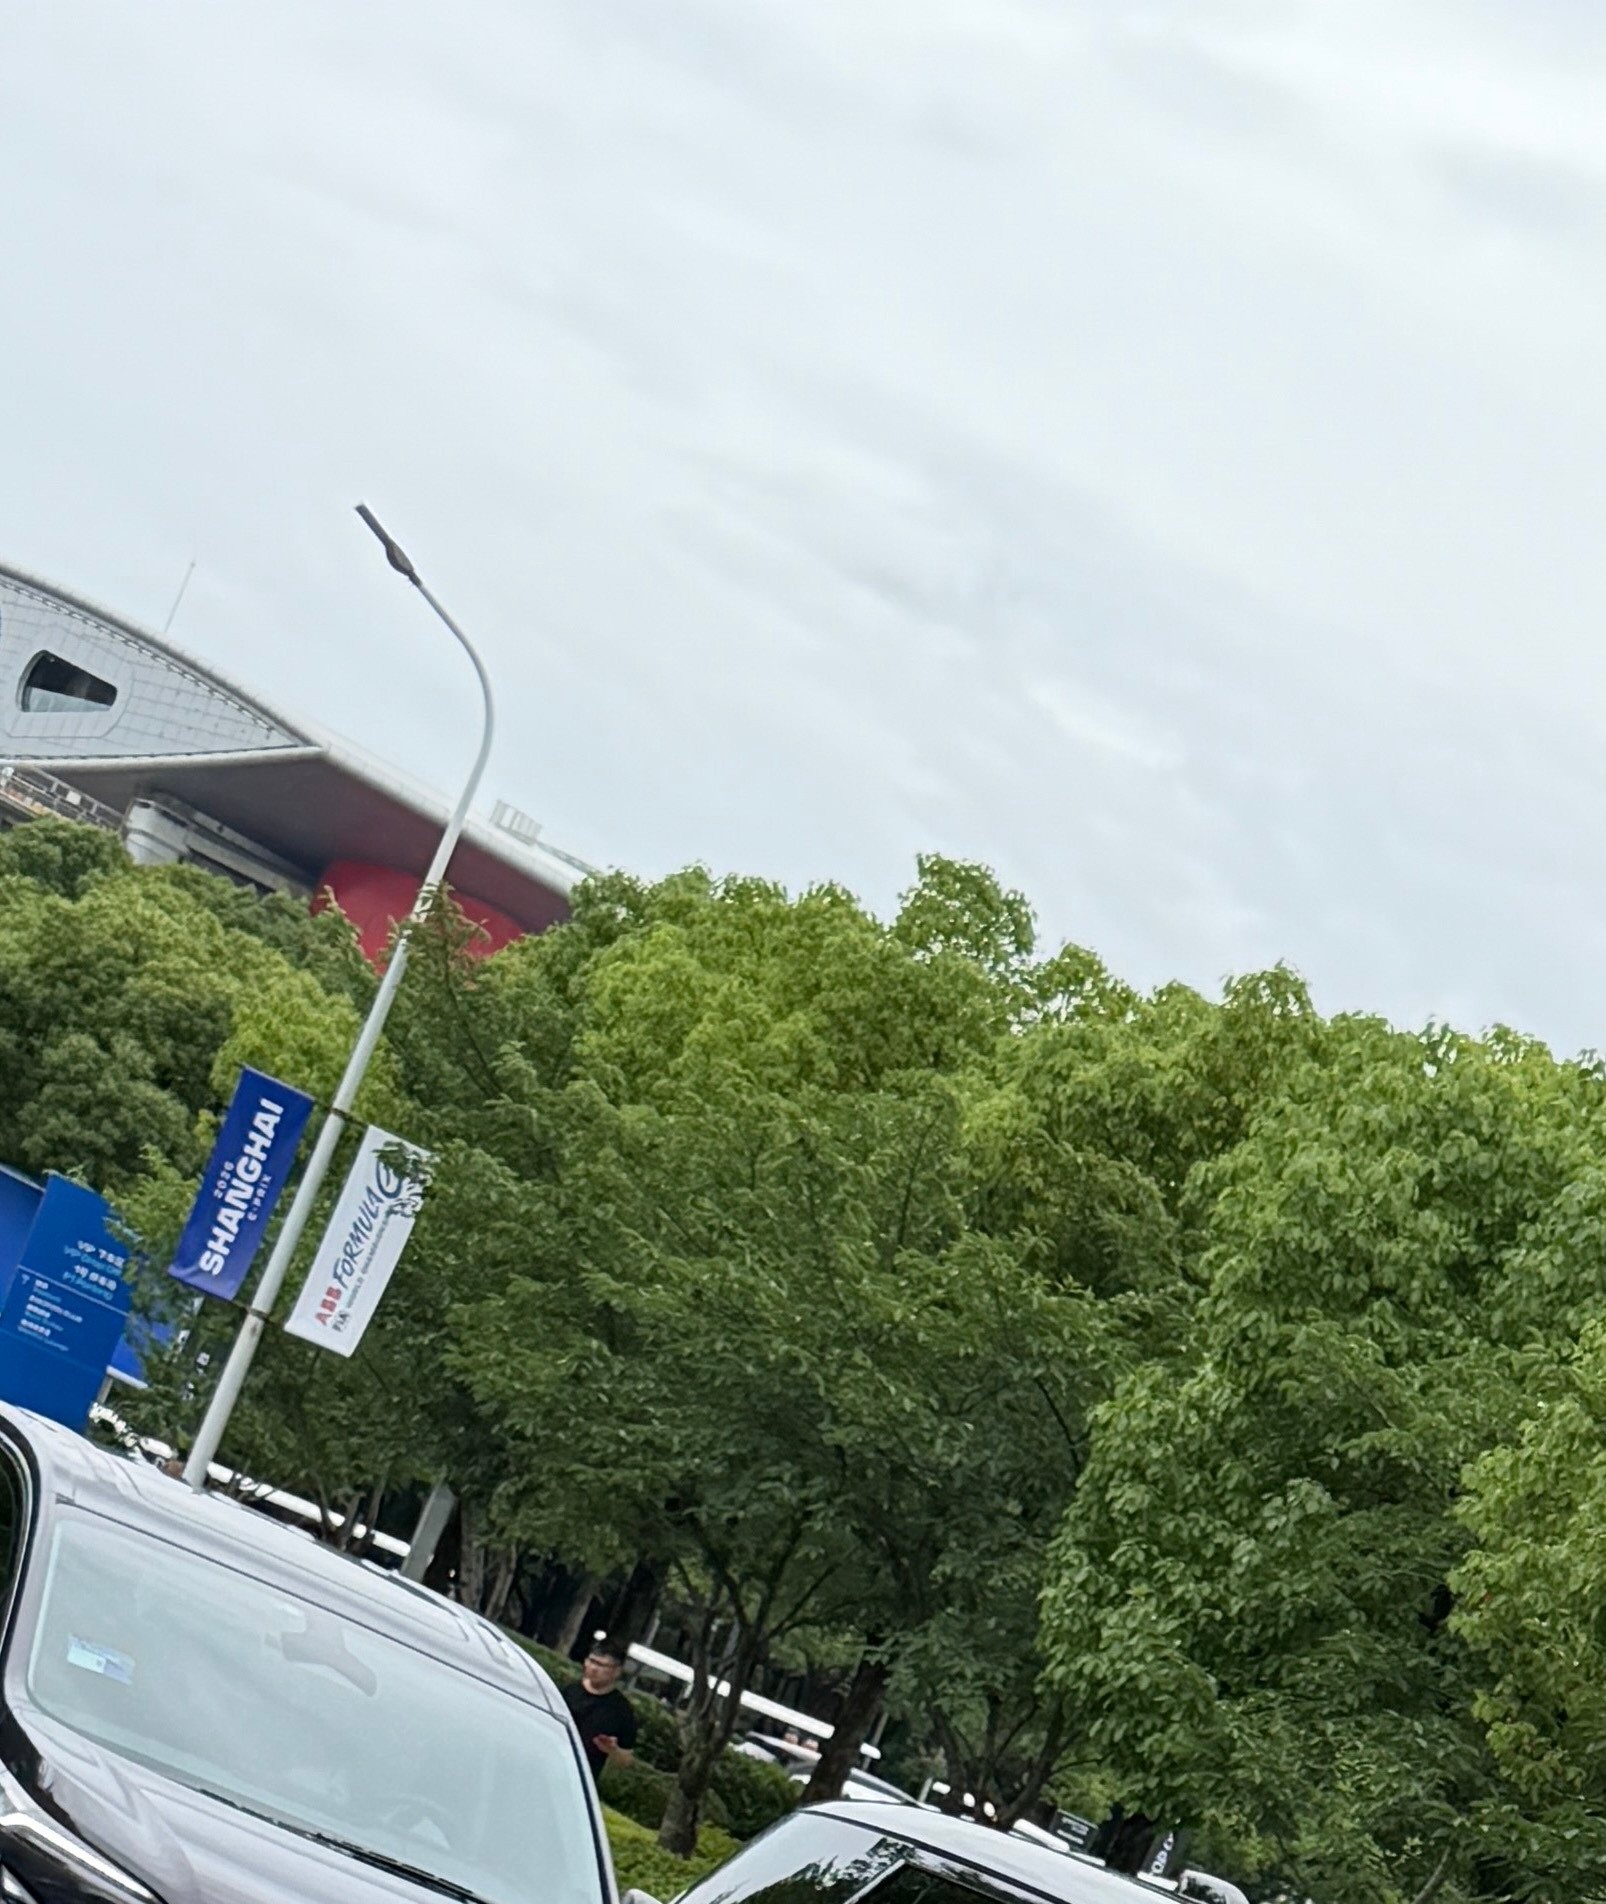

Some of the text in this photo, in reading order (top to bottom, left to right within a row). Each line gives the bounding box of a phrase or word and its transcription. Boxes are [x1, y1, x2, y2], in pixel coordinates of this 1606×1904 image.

[199, 1098, 285, 1276] SHANGHAI
[314, 1286, 342, 1326] ABB
[332, 1185, 384, 1290] FORMULA
